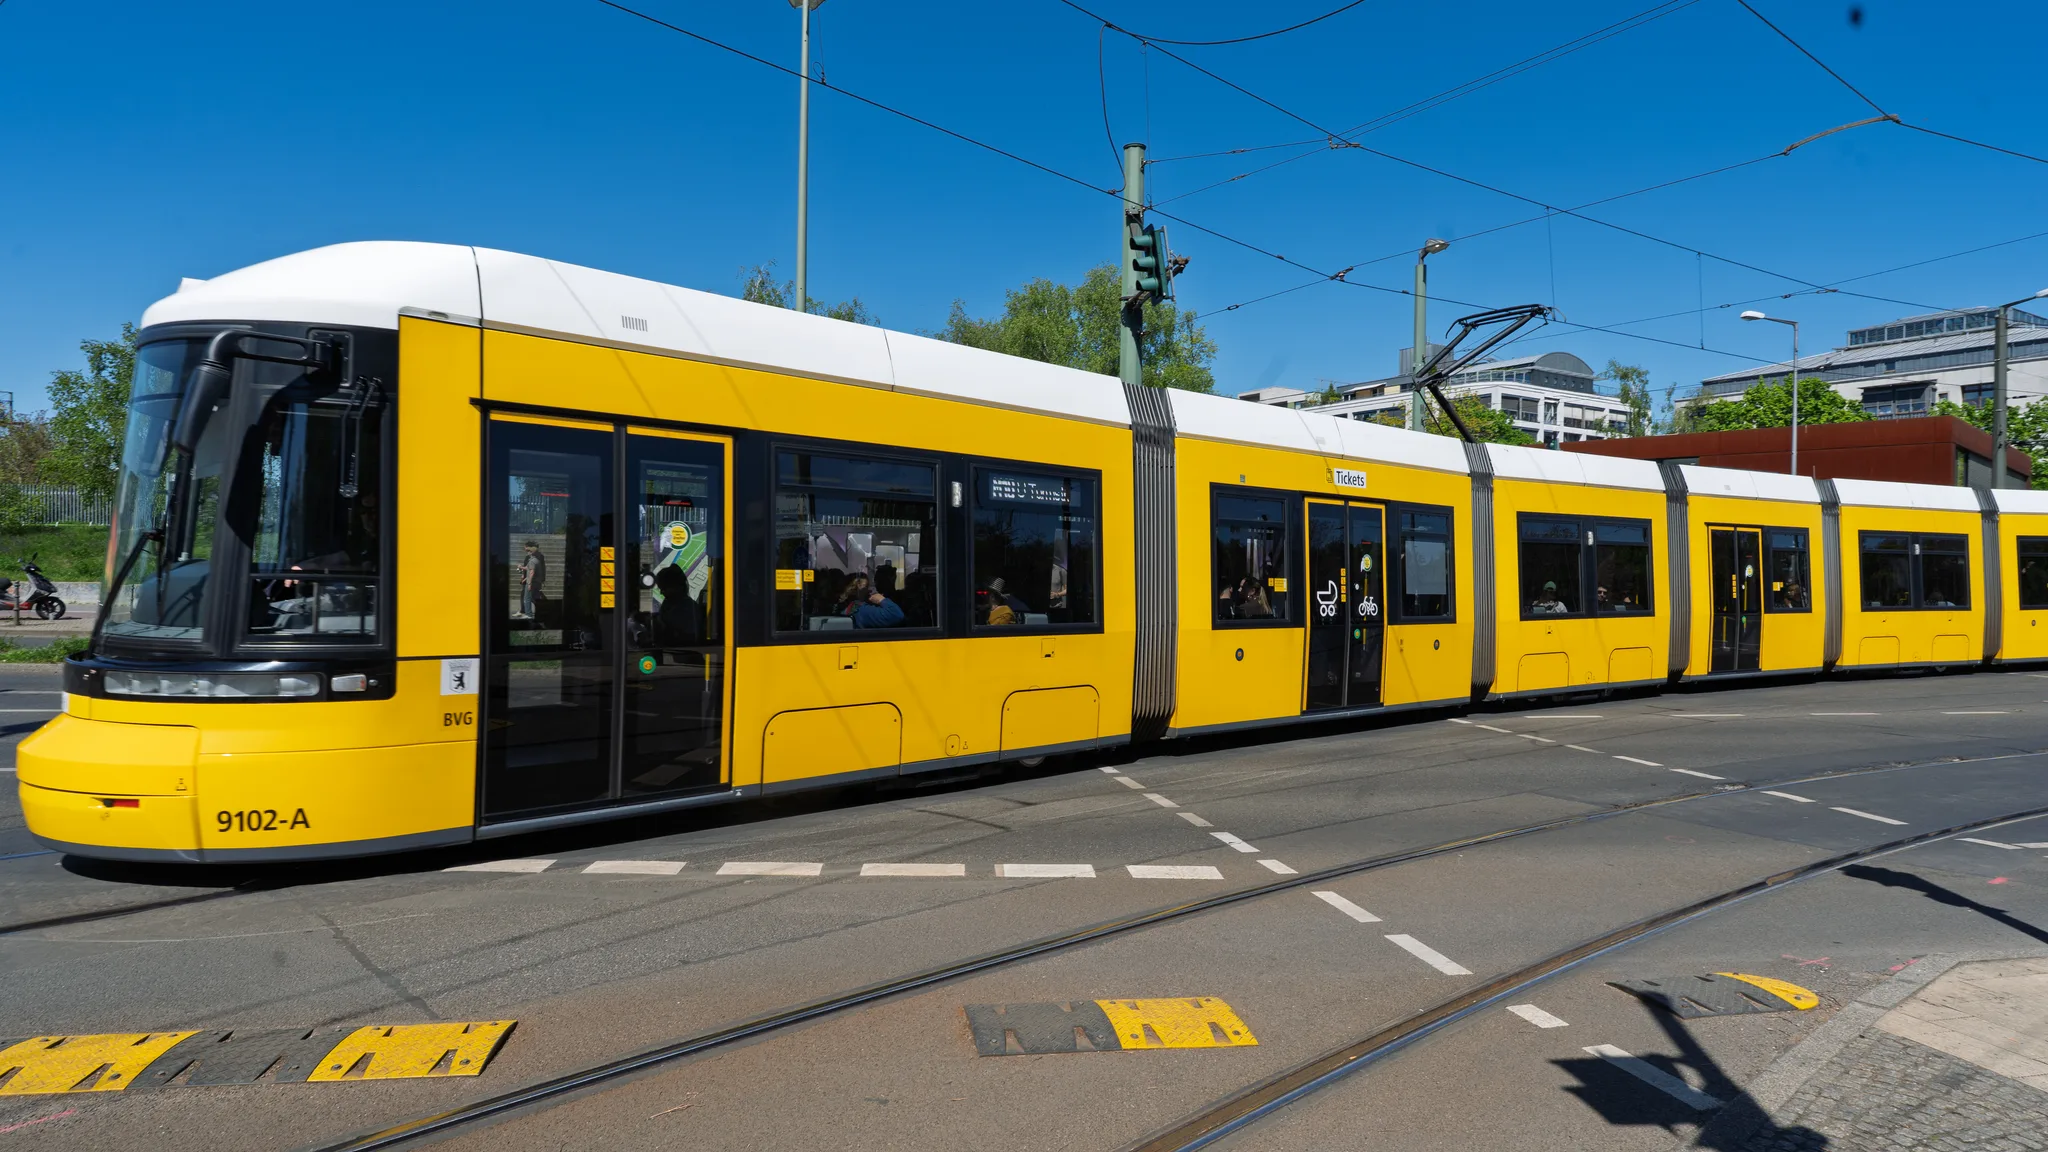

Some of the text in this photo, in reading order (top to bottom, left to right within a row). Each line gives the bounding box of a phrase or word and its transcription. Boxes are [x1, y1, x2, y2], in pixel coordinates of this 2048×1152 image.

[1336, 470, 1365, 487] Tickets
[443, 711, 473, 727] BVG
[217, 807, 311, 833] 9102-A
